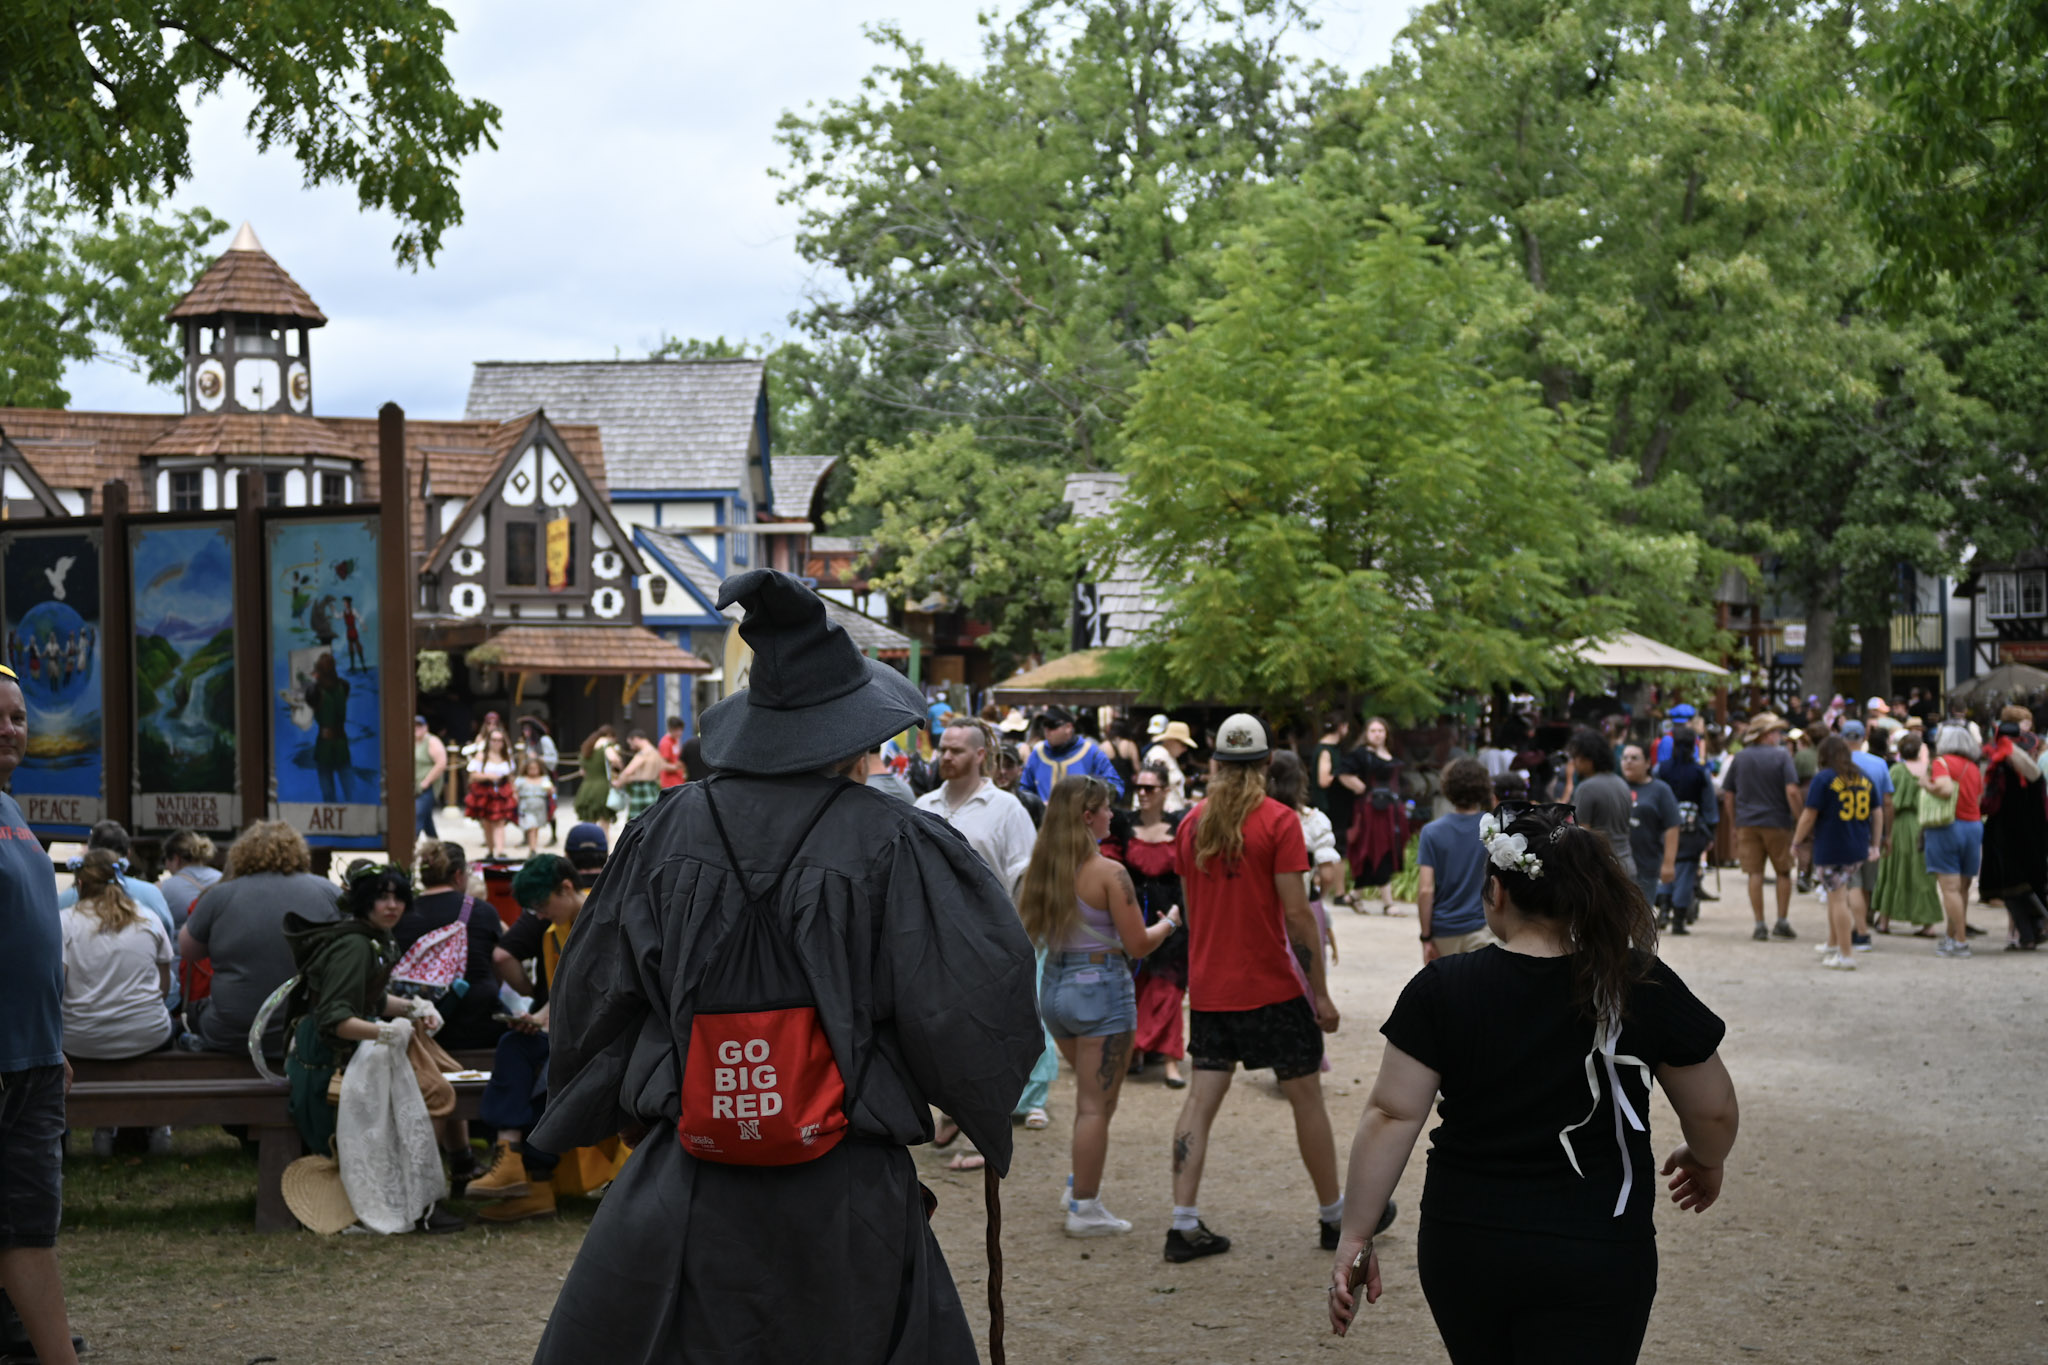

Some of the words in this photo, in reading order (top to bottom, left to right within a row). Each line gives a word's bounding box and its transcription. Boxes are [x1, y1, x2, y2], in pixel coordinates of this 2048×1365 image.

[28, 798, 81, 822] PEACE
[308, 806, 348, 831] ART
[1838, 790, 1870, 821] 38
[154, 811, 219, 827] WONDERS
[718, 1038, 770, 1065] GO
[715, 1064, 777, 1092] BIG
[712, 1091, 783, 1119] RED
[737, 1119, 762, 1141] N
